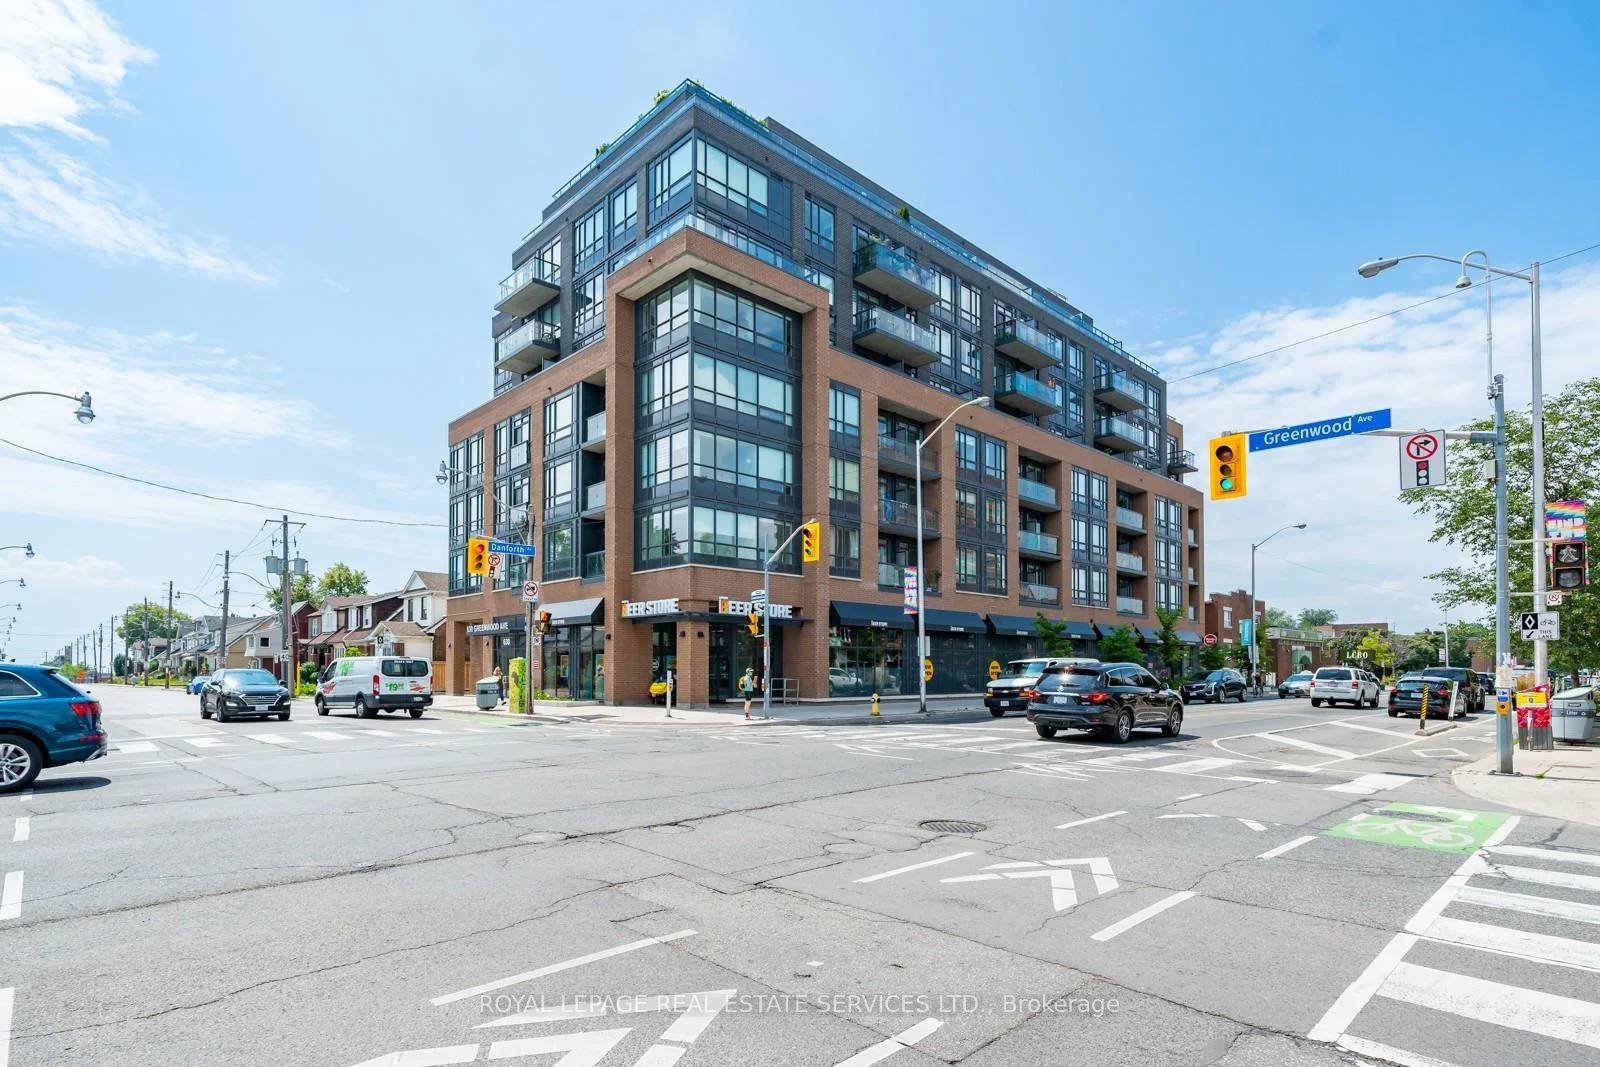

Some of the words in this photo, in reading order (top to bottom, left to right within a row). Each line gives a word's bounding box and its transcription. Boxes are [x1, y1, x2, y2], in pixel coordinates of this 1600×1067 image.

[1263, 418, 1352, 445] Greenwood
[1357, 415, 1373, 424] Ave
[491, 543, 525, 553] Danforth
[621, 600, 645, 616] BEER
[645, 598, 679, 615] STORE
[719, 596, 752, 615] BEER
[473, 622, 499, 632] GREENWOOD
[499, 622, 509, 630] AVE
[1346, 651, 1369, 659] LCBO
